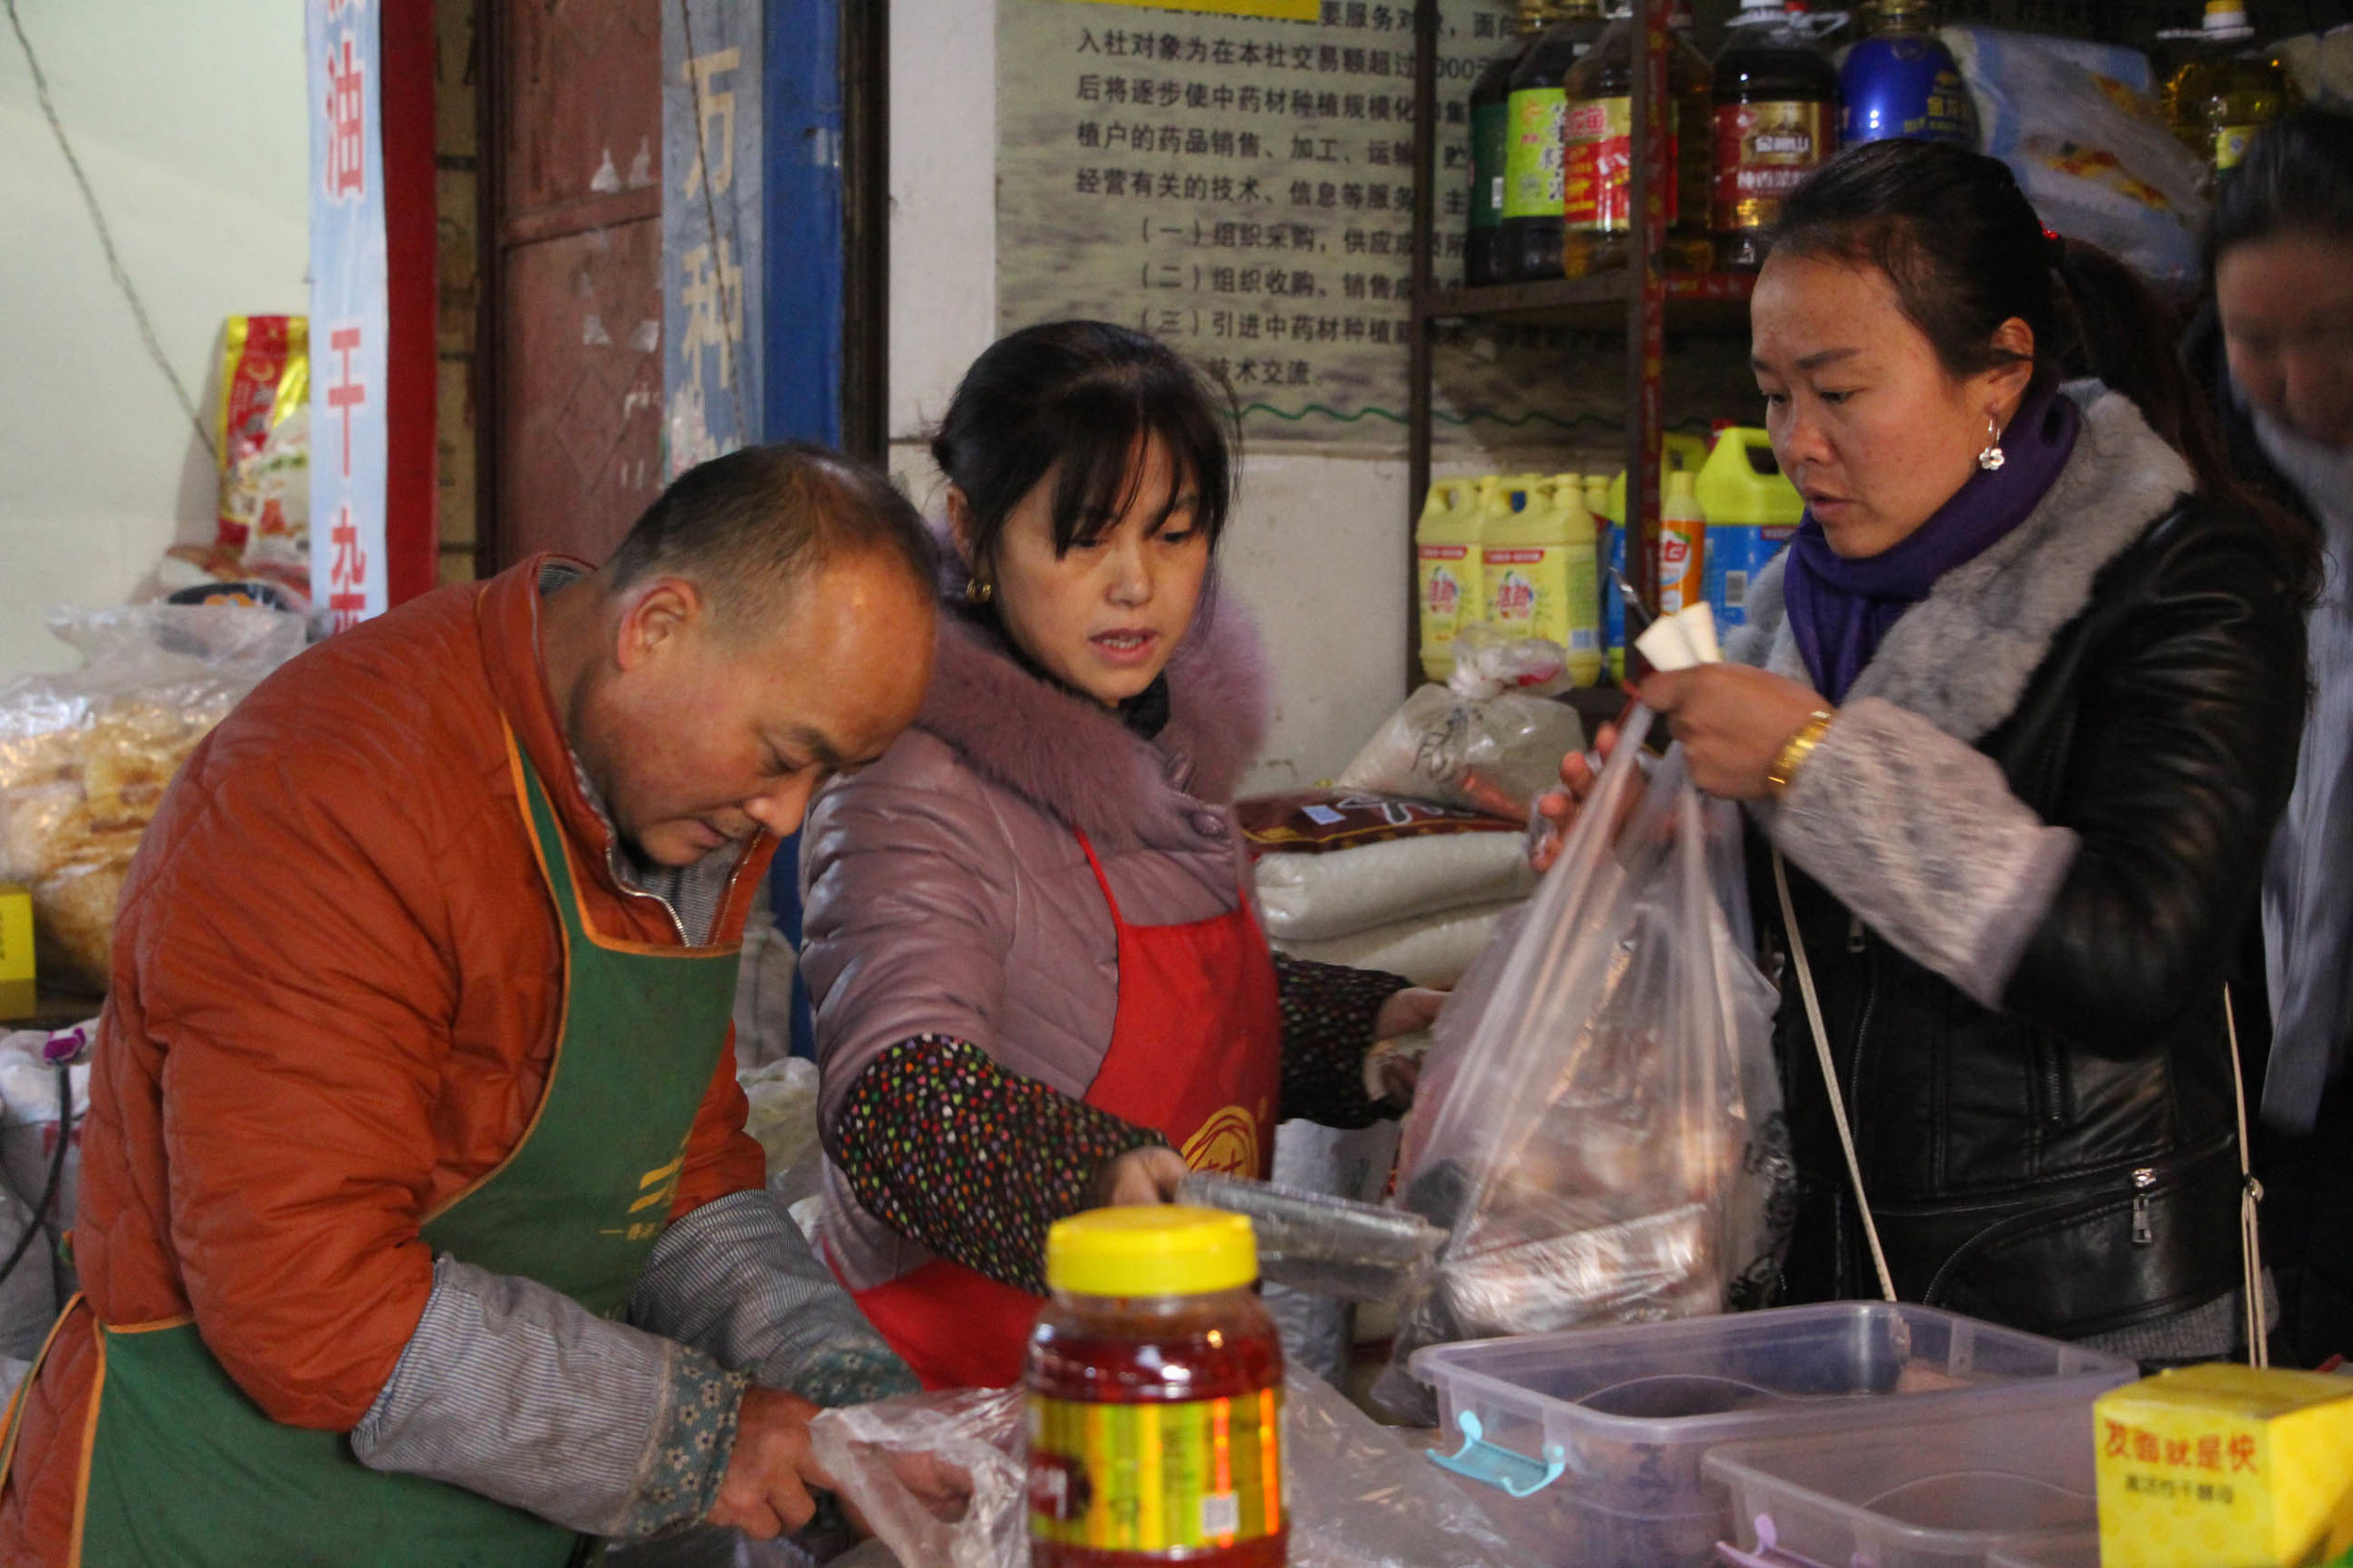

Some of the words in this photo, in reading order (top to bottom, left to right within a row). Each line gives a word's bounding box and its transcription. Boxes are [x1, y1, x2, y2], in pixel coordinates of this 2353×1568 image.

[328, 0, 364, 198] 油
[1077, 74, 1465, 124] 后将逐步使中药材种植规模化集
[1077, 121, 1468, 169] 植户的药品销售、加工、运输贮
[1075, 168, 1467, 214] 经营有关的技术、信息等服务主
[2105, 1420, 2259, 1473] 发面就是快
